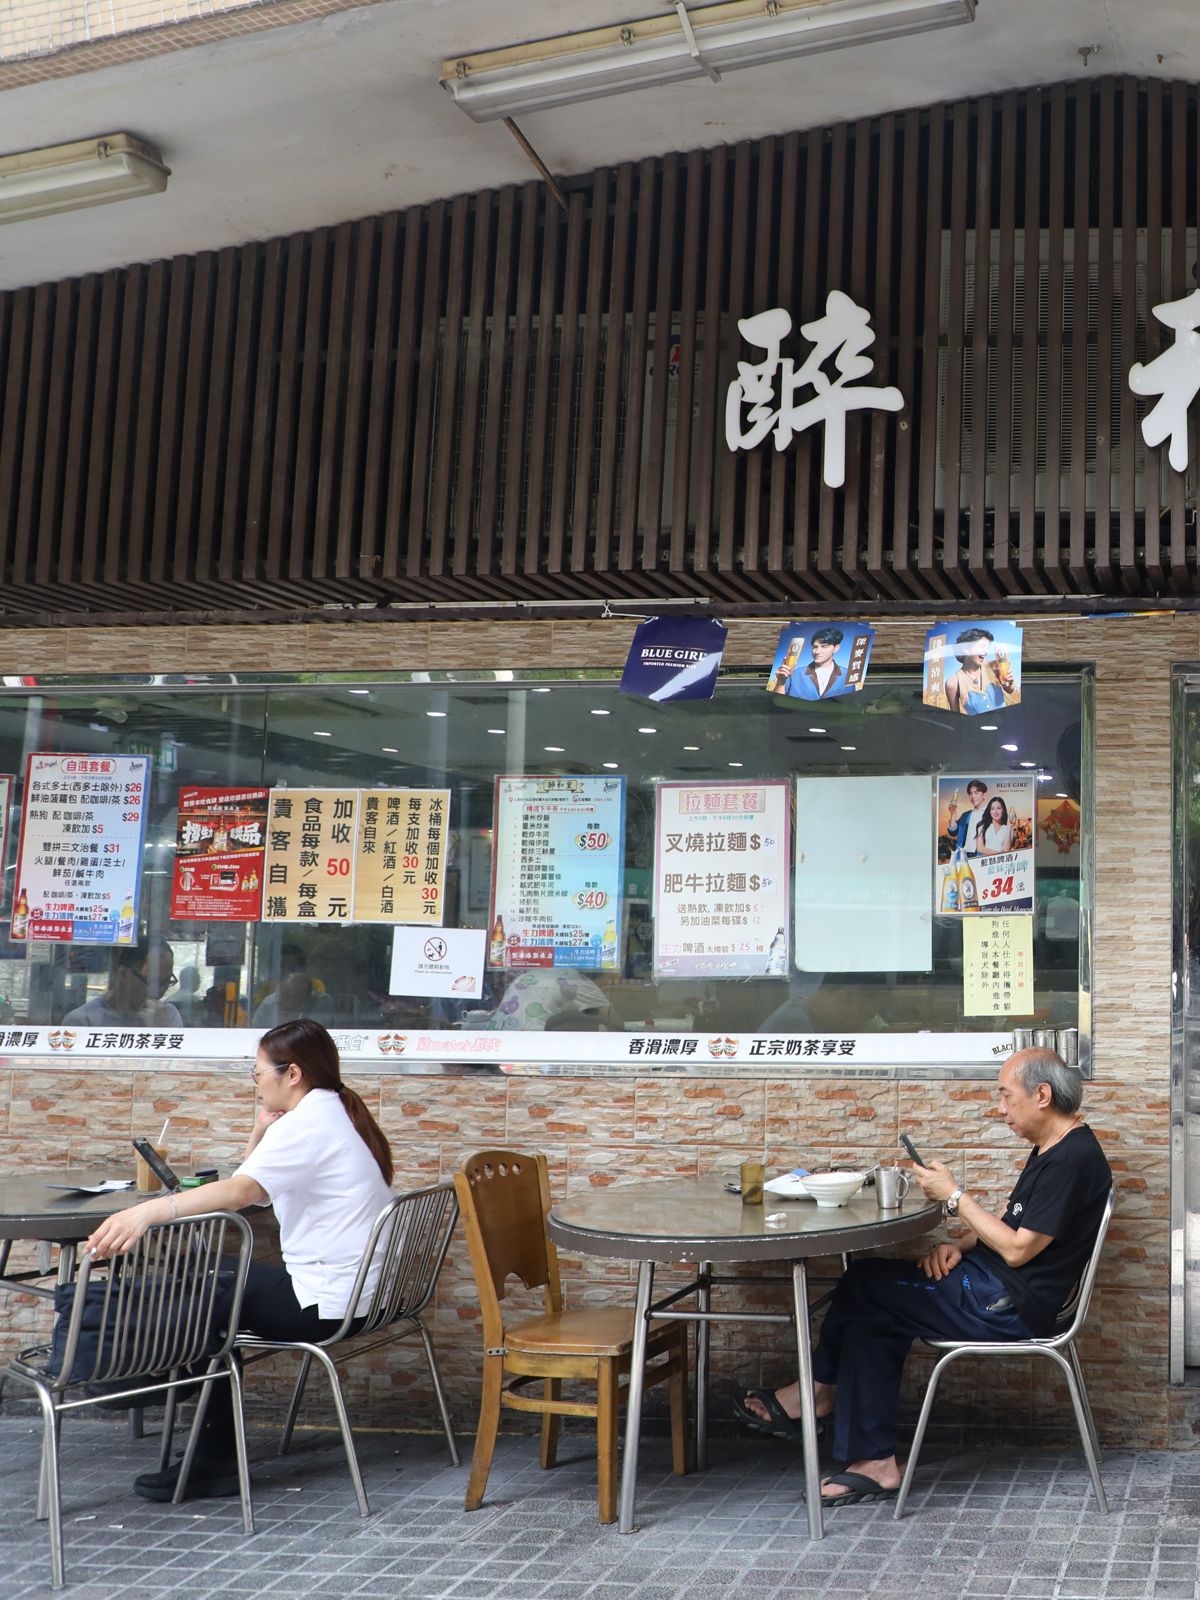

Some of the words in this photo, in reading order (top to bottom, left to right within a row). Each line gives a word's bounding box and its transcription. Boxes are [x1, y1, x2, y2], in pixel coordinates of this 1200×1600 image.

[641, 649, 673, 658] BLUE
[674, 650, 705, 660] GIRL
[67, 761, 111, 772] 自選套餐
[32, 781, 122, 792] 各式多士(西多士除外)
[125, 783, 142, 792] $26
[80, 795, 120, 804] 配咖啡/茶
[123, 795, 140, 805] $26
[685, 792, 759, 811] 拉麵套餐
[30, 810, 48, 820] 熱狗
[52, 811, 61, 820] 配
[64, 811, 94, 821] 咖啡/茶
[122, 812, 139, 821] $29
[362, 797, 380, 854] 貴客自來
[42, 842, 98, 852] 雙拼三文治餐
[104, 843, 119, 852] $31
[402, 797, 422, 885] 每支加收30元
[579, 833, 607, 848] $50
[665, 832, 761, 853] 叉燒拉麵$
[267, 798, 294, 917] 貴客自攜
[327, 799, 353, 917] 加收50元
[421, 798, 443, 914] 冰桶每個加收30元
[664, 873, 761, 893] 肥牛拉麵$
[982, 876, 1014, 900] $34
[45, 903, 75, 911] 生力啤酒
[577, 891, 605, 907] $40
[661, 943, 704, 953] 生力啤酒
[0, 1032, 39, 1047] 濃厚
[85, 1033, 184, 1050] 正宗奶茶享受
[629, 1038, 698, 1055] 香滑濃厚
[749, 1039, 856, 1056] 正宗奶茶享受
[992, 1044, 1013, 1055] BLAC
